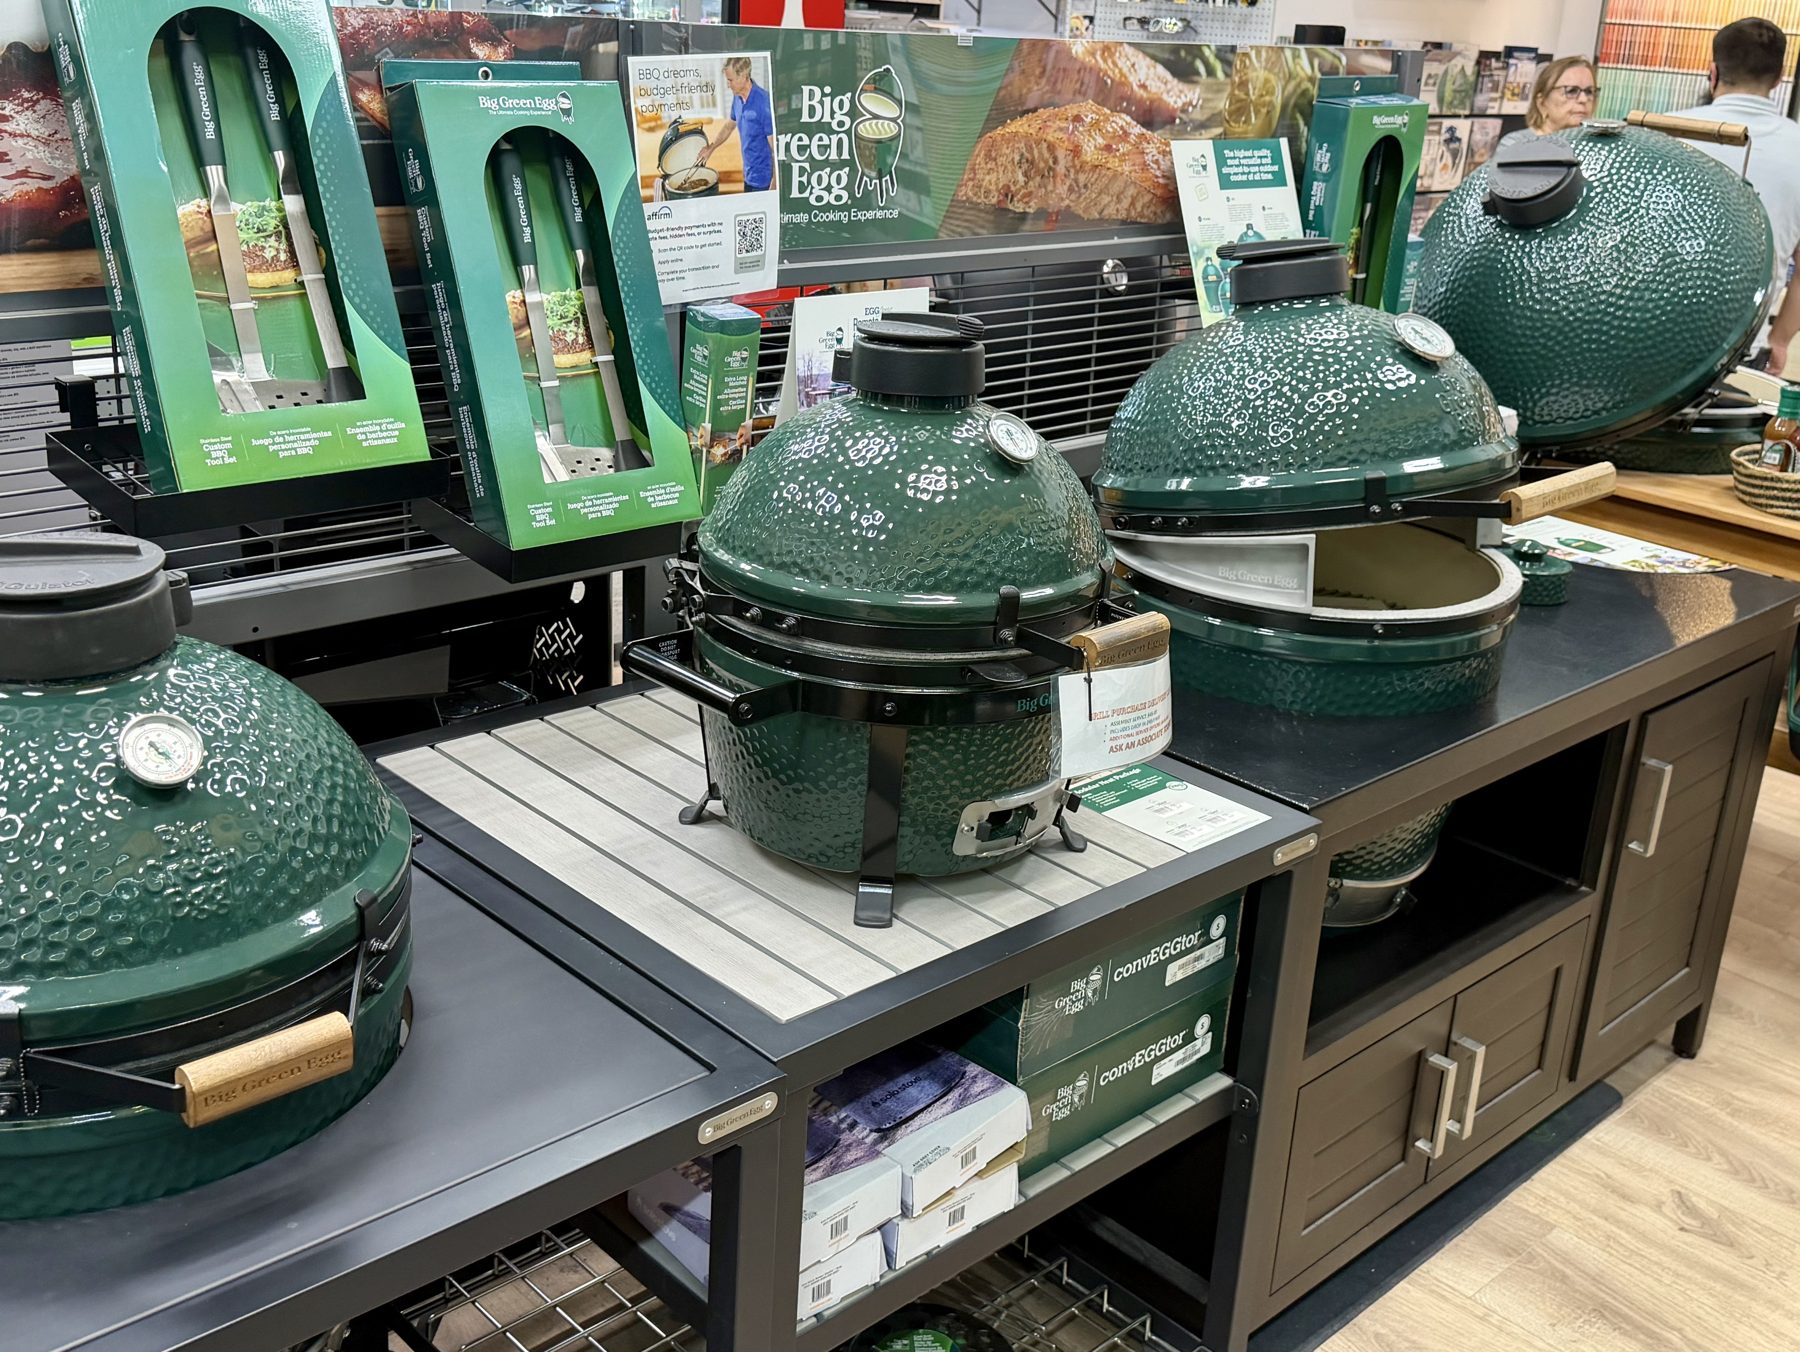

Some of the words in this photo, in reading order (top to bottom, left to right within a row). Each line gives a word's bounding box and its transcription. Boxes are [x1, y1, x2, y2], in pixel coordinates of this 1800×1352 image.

[257, 48, 268, 69] Egg
[193, 64, 205, 86] Egg
[638, 68, 660, 80] BBQ
[662, 68, 702, 79] dreams,
[263, 70, 276, 102] Green
[639, 82, 716, 98] budget-friendly
[198, 87, 211, 121] Green
[478, 96, 499, 110] Big
[500, 96, 535, 108] Green
[534, 96, 557, 110] Egg
[640, 100, 691, 115] payments
[800, 85, 852, 131] Big
[270, 103, 280, 121] Big
[205, 121, 215, 139] Big
[777, 132, 850, 160] reen
[1224, 150, 1234, 158] The
[565, 157, 574, 177] Egg
[1227, 158, 1240, 166] most
[1261, 156, 1272, 164] and
[512, 175, 522, 196] Egg
[569, 177, 579, 207] Green
[790, 162, 850, 206] Egg
[517, 196, 529, 226] Green
[575, 206, 583, 223] Big
[647, 211, 671, 221] affirm
[780, 211, 809, 224] timate
[811, 210, 849, 223] Cooking
[851, 208, 899, 221] Experience
[523, 226, 532, 243] Big
[684, 222, 707, 231] payments
[864, 307, 880, 316] EGG
[346, 425, 380, 435] Ensemble
[381, 421, 406, 431] d'outils
[357, 432, 367, 441] de
[367, 429, 400, 439] barbecue
[252, 436, 274, 446] Juego
[274, 435, 285, 444] de
[284, 429, 333, 442] herramientas
[268, 438, 320, 452] personalizado
[362, 437, 398, 447] artisanaux
[203, 442, 233, 452] Custom
[210, 449, 228, 459] BBQ
[279, 449, 296, 458] para
[297, 446, 313, 456] BBQ
[205, 458, 223, 467] Tool
[223, 456, 238, 464] Set
[639, 489, 665, 498] Ensemble
[665, 485, 685, 494] d'outils
[655, 492, 680, 501] barbecue
[567, 502, 584, 511] Juego
[585, 500, 593, 508] de
[592, 494, 630, 506] herramientas
[580, 502, 620, 515] personalizado
[651, 499, 679, 509] artisanaux
[529, 507, 553, 516] Custom
[535, 513, 550, 522] BBQ
[588, 512, 601, 520] para
[602, 509, 615, 518] BBQ
[532, 520, 546, 528] Tool
[545, 519, 556, 527] Set
[1218, 566, 1237, 580] Big
[1238, 569, 1273, 584] Green
[1273, 575, 1298, 589] Egg
[1016, 697, 1038, 713] Big
[1108, 743, 1124, 755] ASK
[1125, 740, 1136, 751] AN
[1136, 728, 1164, 748] ASSOCIATE
[1109, 732, 1135, 741] ADDITIONAL
[1113, 930, 1202, 983] convEGGtor
[1070, 977, 1087, 994] Big
[1055, 990, 1085, 1010] Green
[1065, 1001, 1085, 1016] Egg
[1100, 1030, 1187, 1087] convEGGtor
[203, 1089, 237, 1108] Big
[241, 1066, 301, 1095] Green
[306, 1049, 343, 1070] Egg
[880, 1089, 900, 1104] solo
[898, 1076, 922, 1092] stove
[1057, 1083, 1073, 1099] Big
[1042, 1095, 1073, 1117] Green
[1052, 1105, 1071, 1122] Egg
[713, 1122, 726, 1133] Big
[726, 1111, 749, 1126] Green
[749, 1106, 763, 1116] Egg
